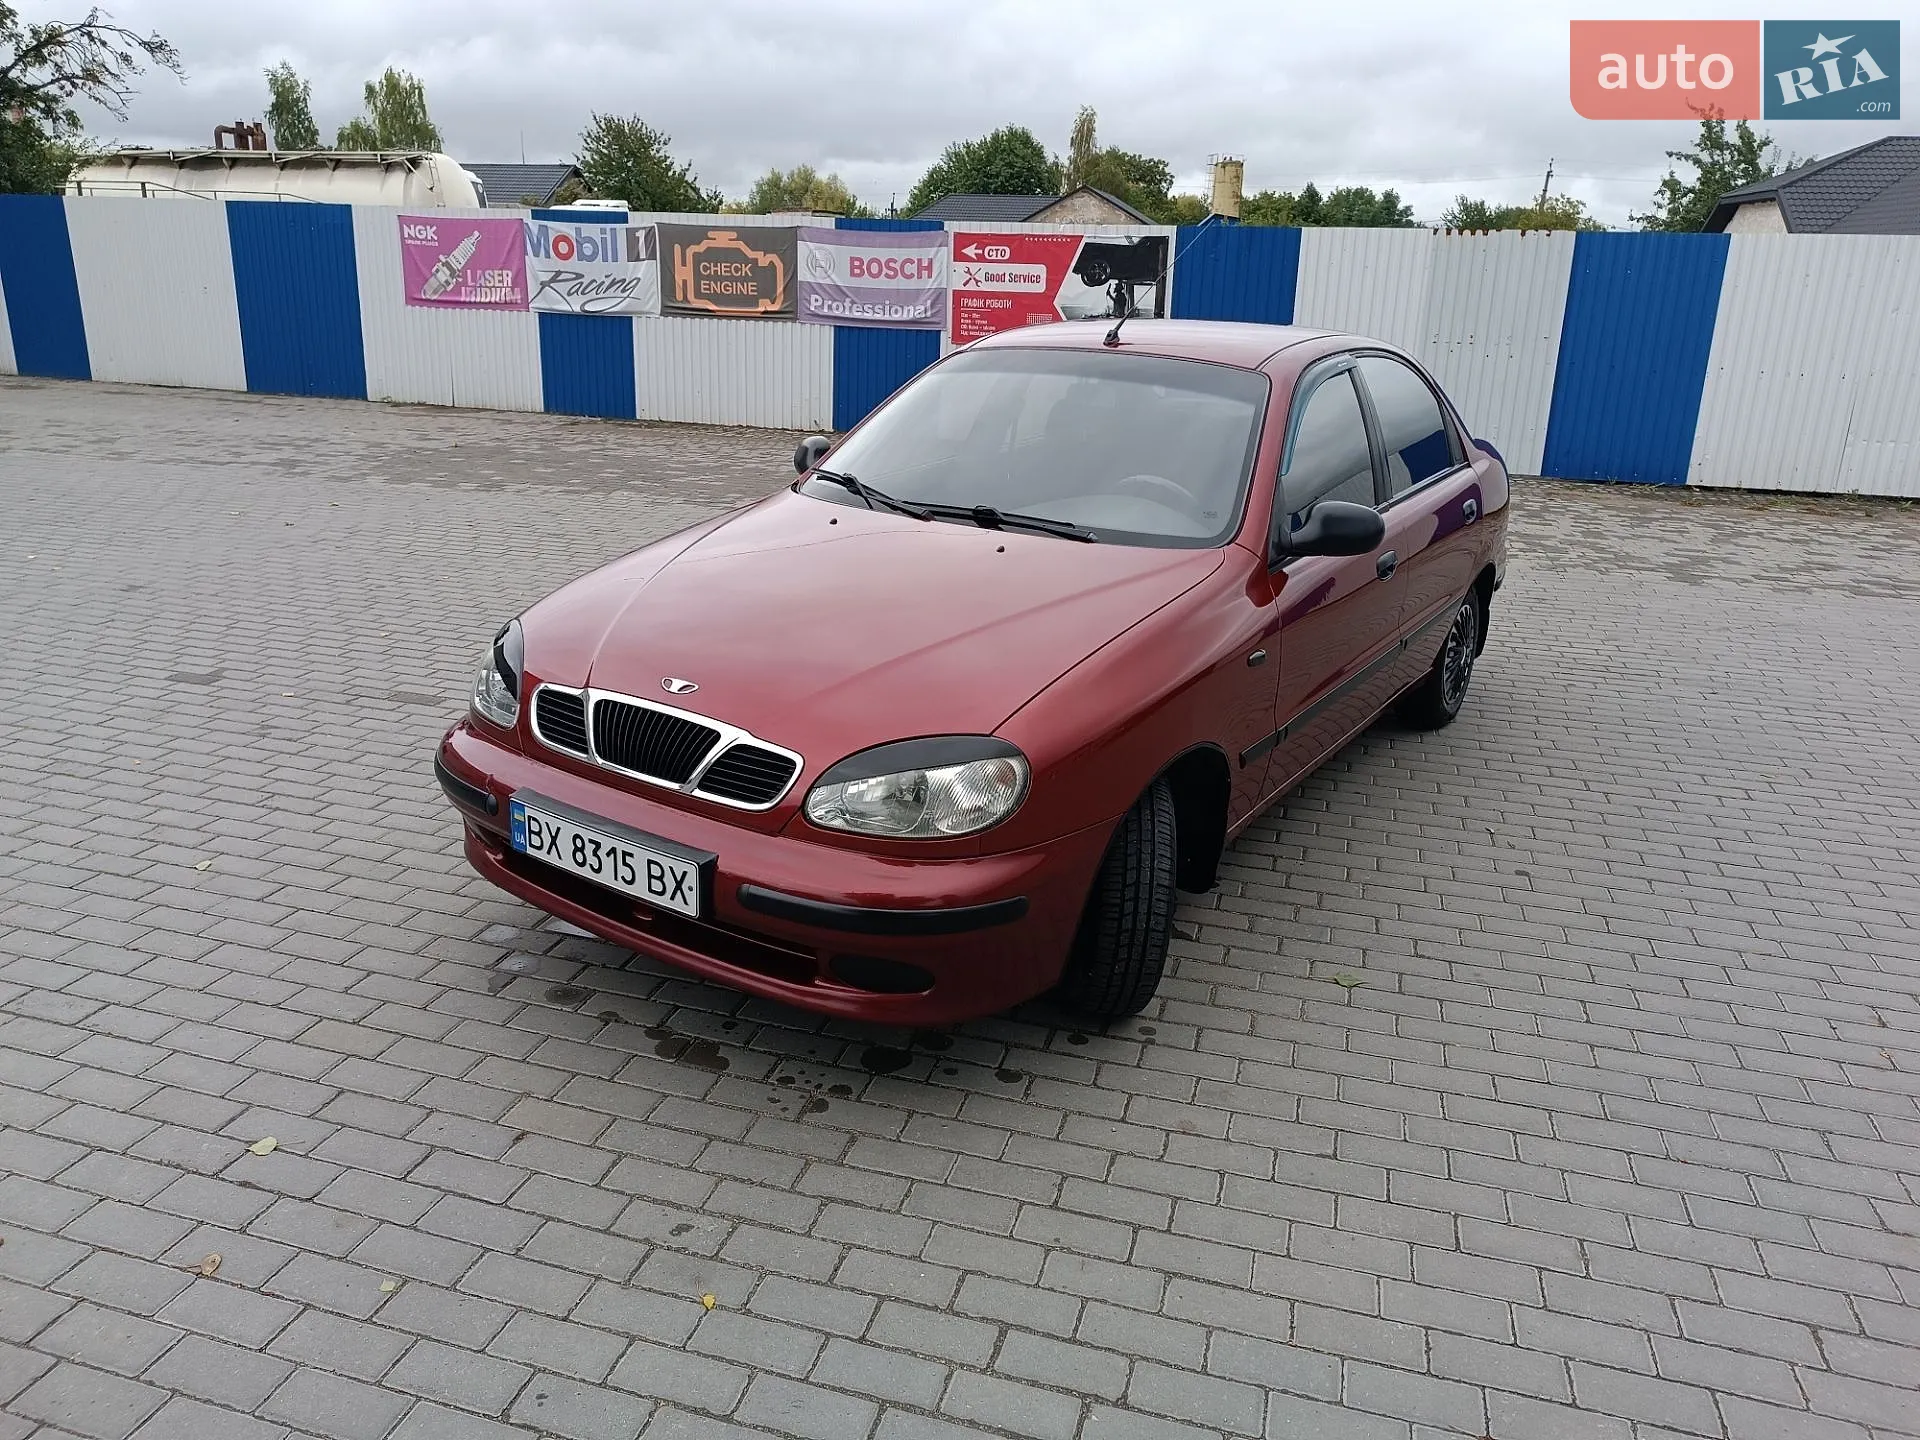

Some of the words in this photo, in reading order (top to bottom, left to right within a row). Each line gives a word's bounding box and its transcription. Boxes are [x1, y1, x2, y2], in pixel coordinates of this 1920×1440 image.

[403, 224, 438, 241] NGK
[524, 222, 619, 263] Mobil
[634, 229, 647, 259] 1
[987, 247, 1007, 258] СТО
[700, 262, 753, 277] CHECK
[849, 256, 934, 280] BOSCH
[466, 269, 512, 287] LASER
[984, 271, 1006, 283] Good
[1008, 272, 1041, 284] Service
[461, 286, 521, 304] IRIDIUM
[528, 269, 641, 313] Racing
[700, 280, 758, 296] ENGINE
[809, 294, 931, 319] Professional
[986, 299, 1012, 309] РОБОТИ
[514, 831, 526, 846] UA
[527, 815, 563, 861] BX
[571, 833, 636, 886] 8315
[646, 858, 689, 905] BX
